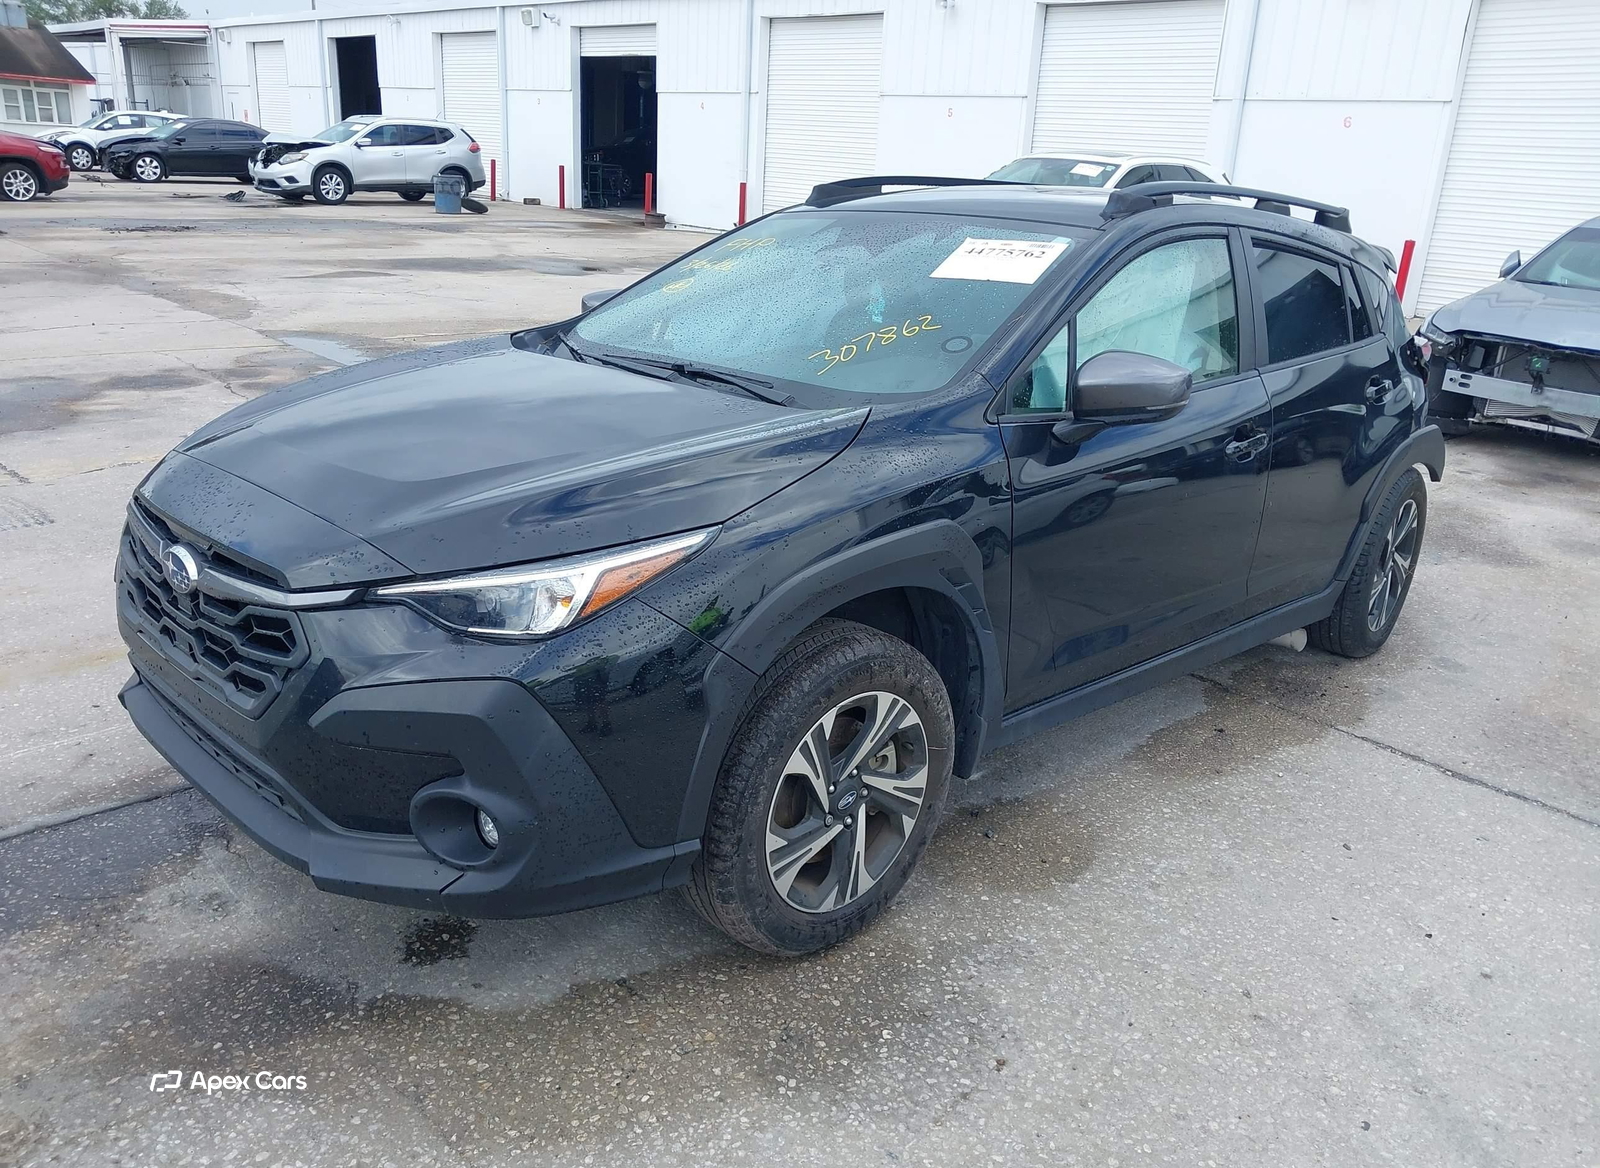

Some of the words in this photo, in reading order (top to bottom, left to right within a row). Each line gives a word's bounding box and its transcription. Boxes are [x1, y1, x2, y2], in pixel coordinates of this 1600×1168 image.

[947, 107, 953, 118] 5
[1343, 116, 1352, 129] 6
[964, 247, 1047, 259] 44775762
[807, 315, 943, 376] 307862
